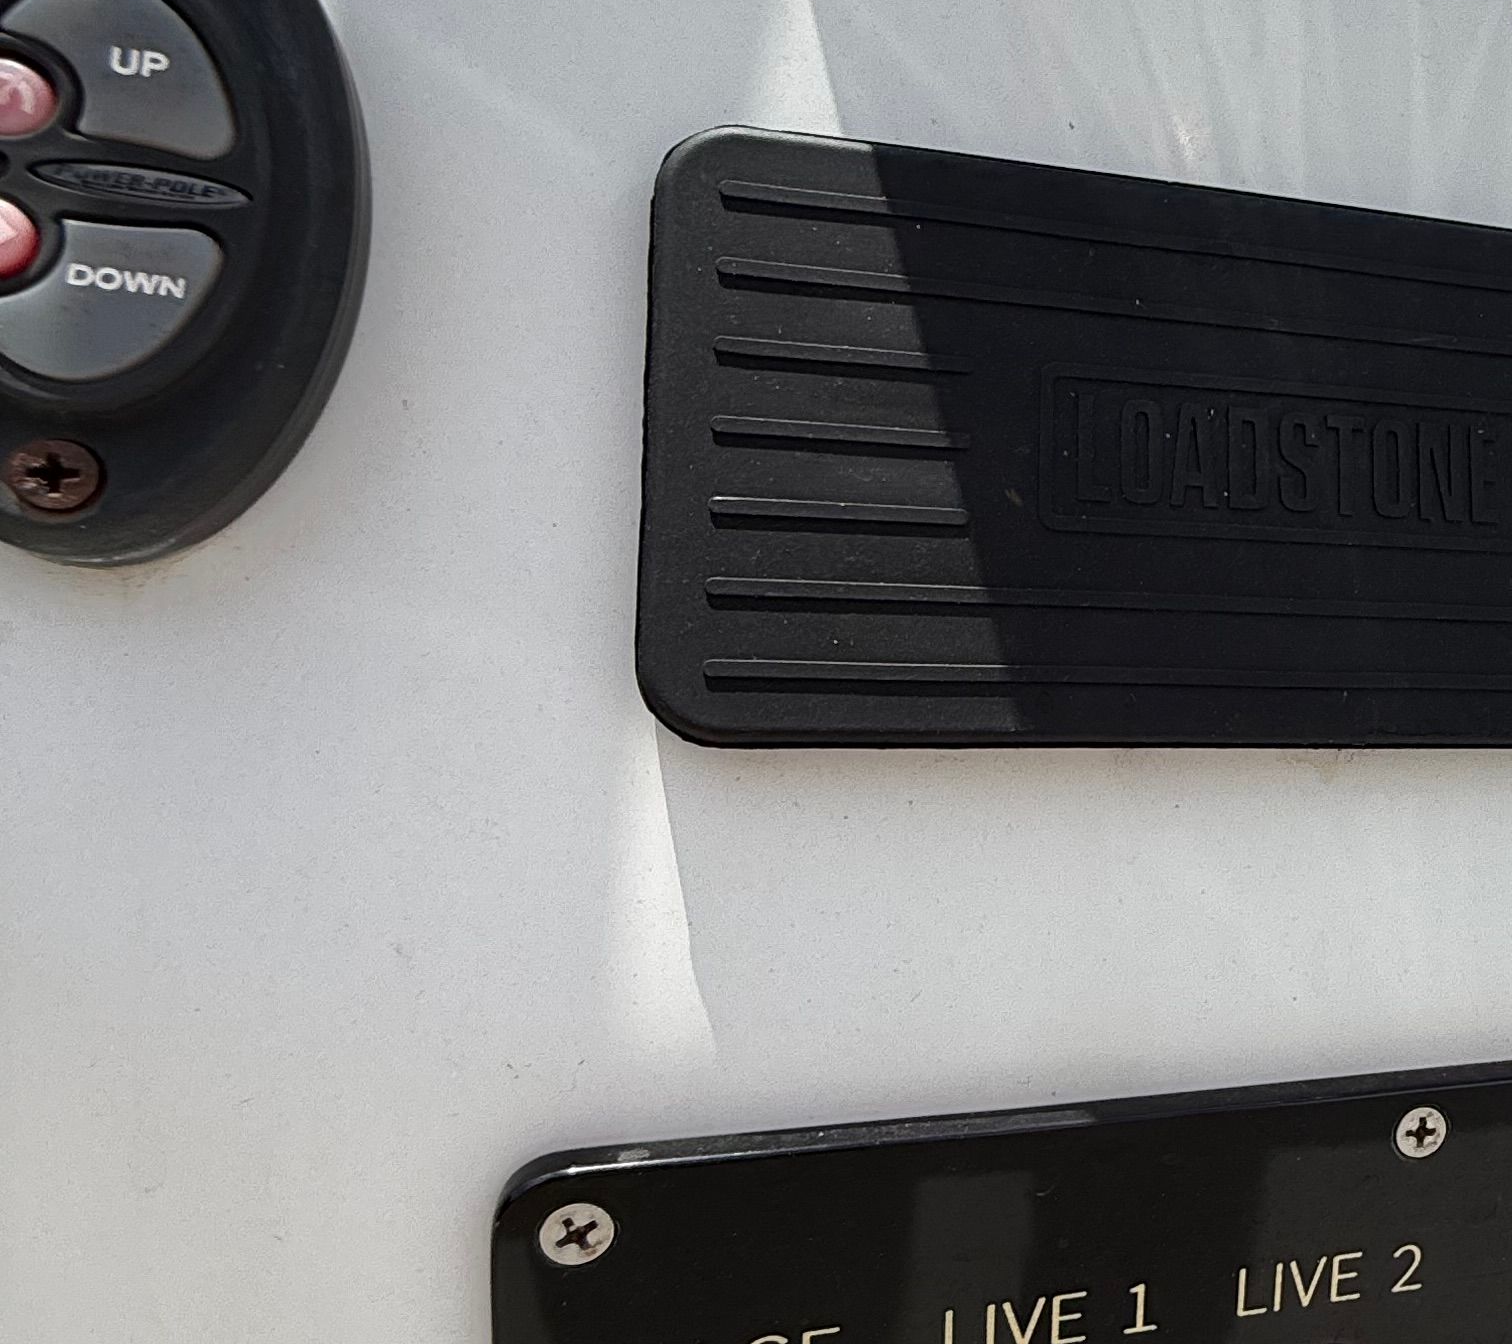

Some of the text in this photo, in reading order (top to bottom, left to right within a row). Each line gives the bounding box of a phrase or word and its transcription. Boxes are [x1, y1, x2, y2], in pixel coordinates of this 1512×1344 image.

[110, 45, 170, 77] UP
[66, 262, 186, 299] DOWN
[1075, 390, 1503, 526] LOADSTONE
[1236, 1244, 1424, 1318] LIVE 2
[1123, 1282, 1158, 1335] 1
